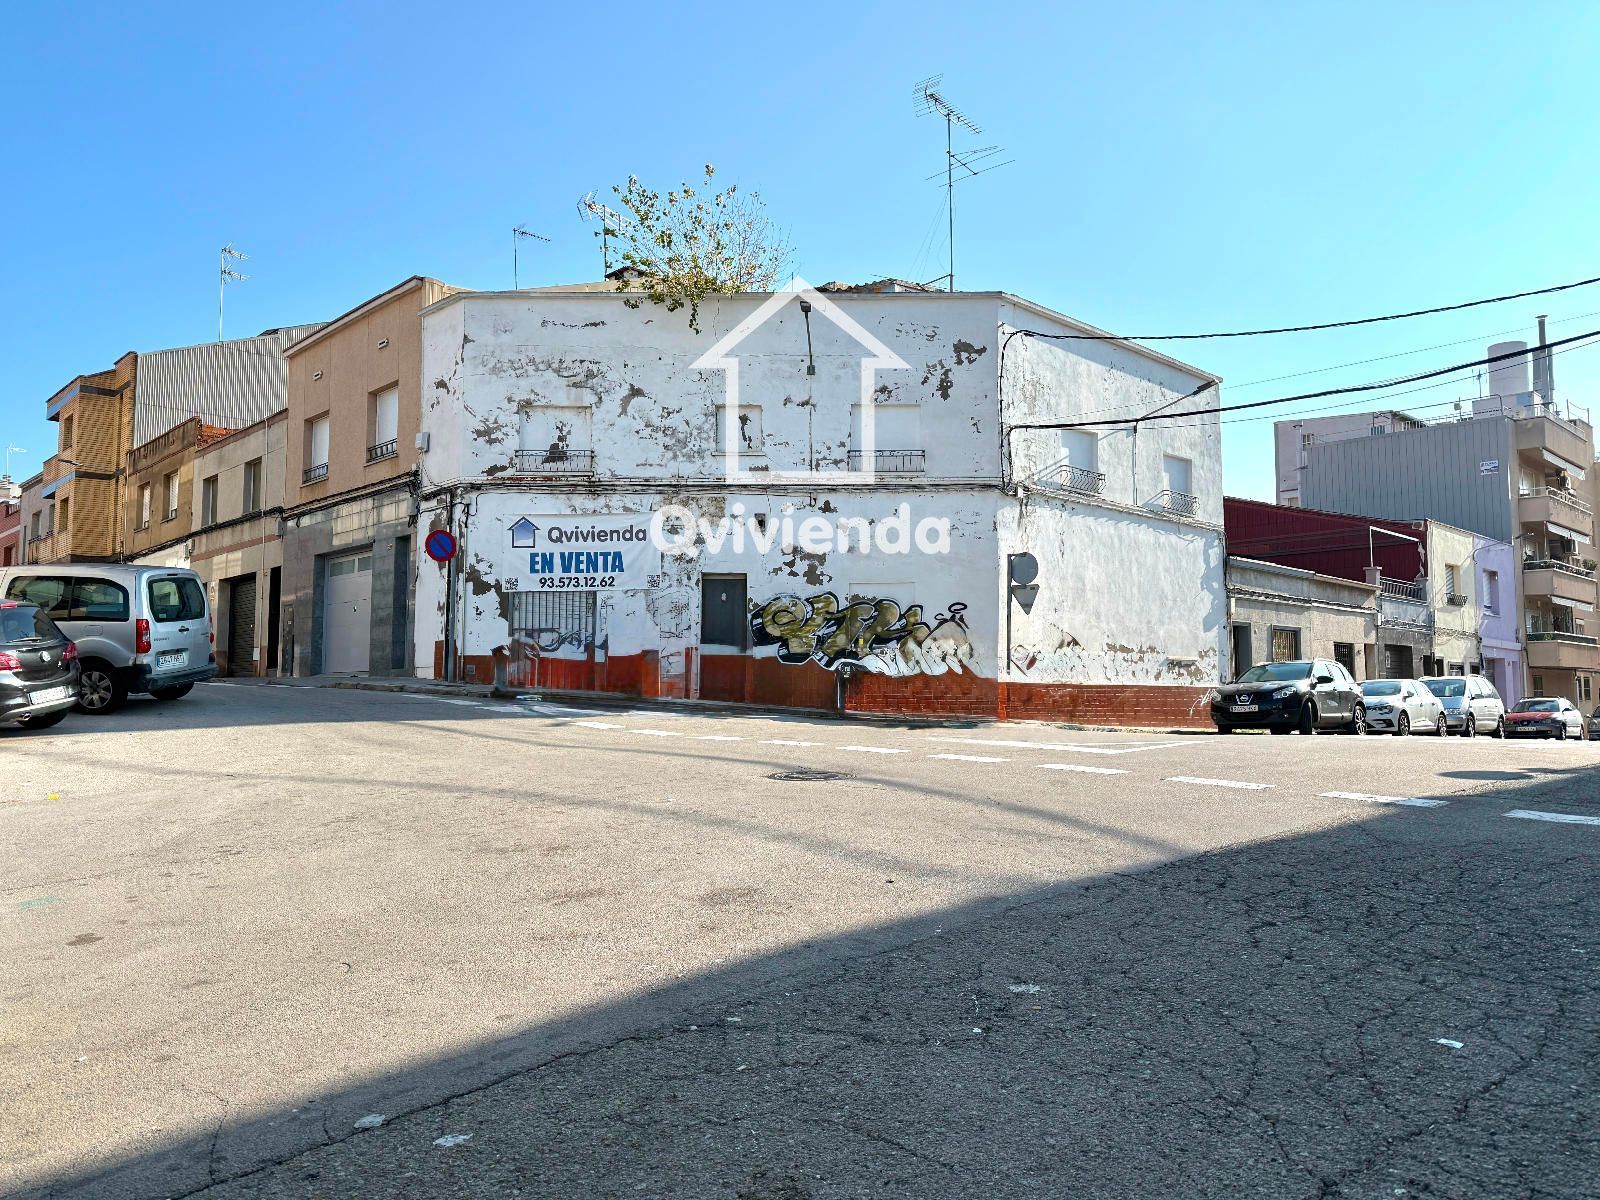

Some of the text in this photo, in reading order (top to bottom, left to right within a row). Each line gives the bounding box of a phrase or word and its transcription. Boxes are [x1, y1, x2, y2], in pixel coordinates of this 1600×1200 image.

[547, 524, 647, 544] Qvivienda
[529, 551, 625, 574] EN VENTA
[538, 576, 616, 589] 93.573.12.62
